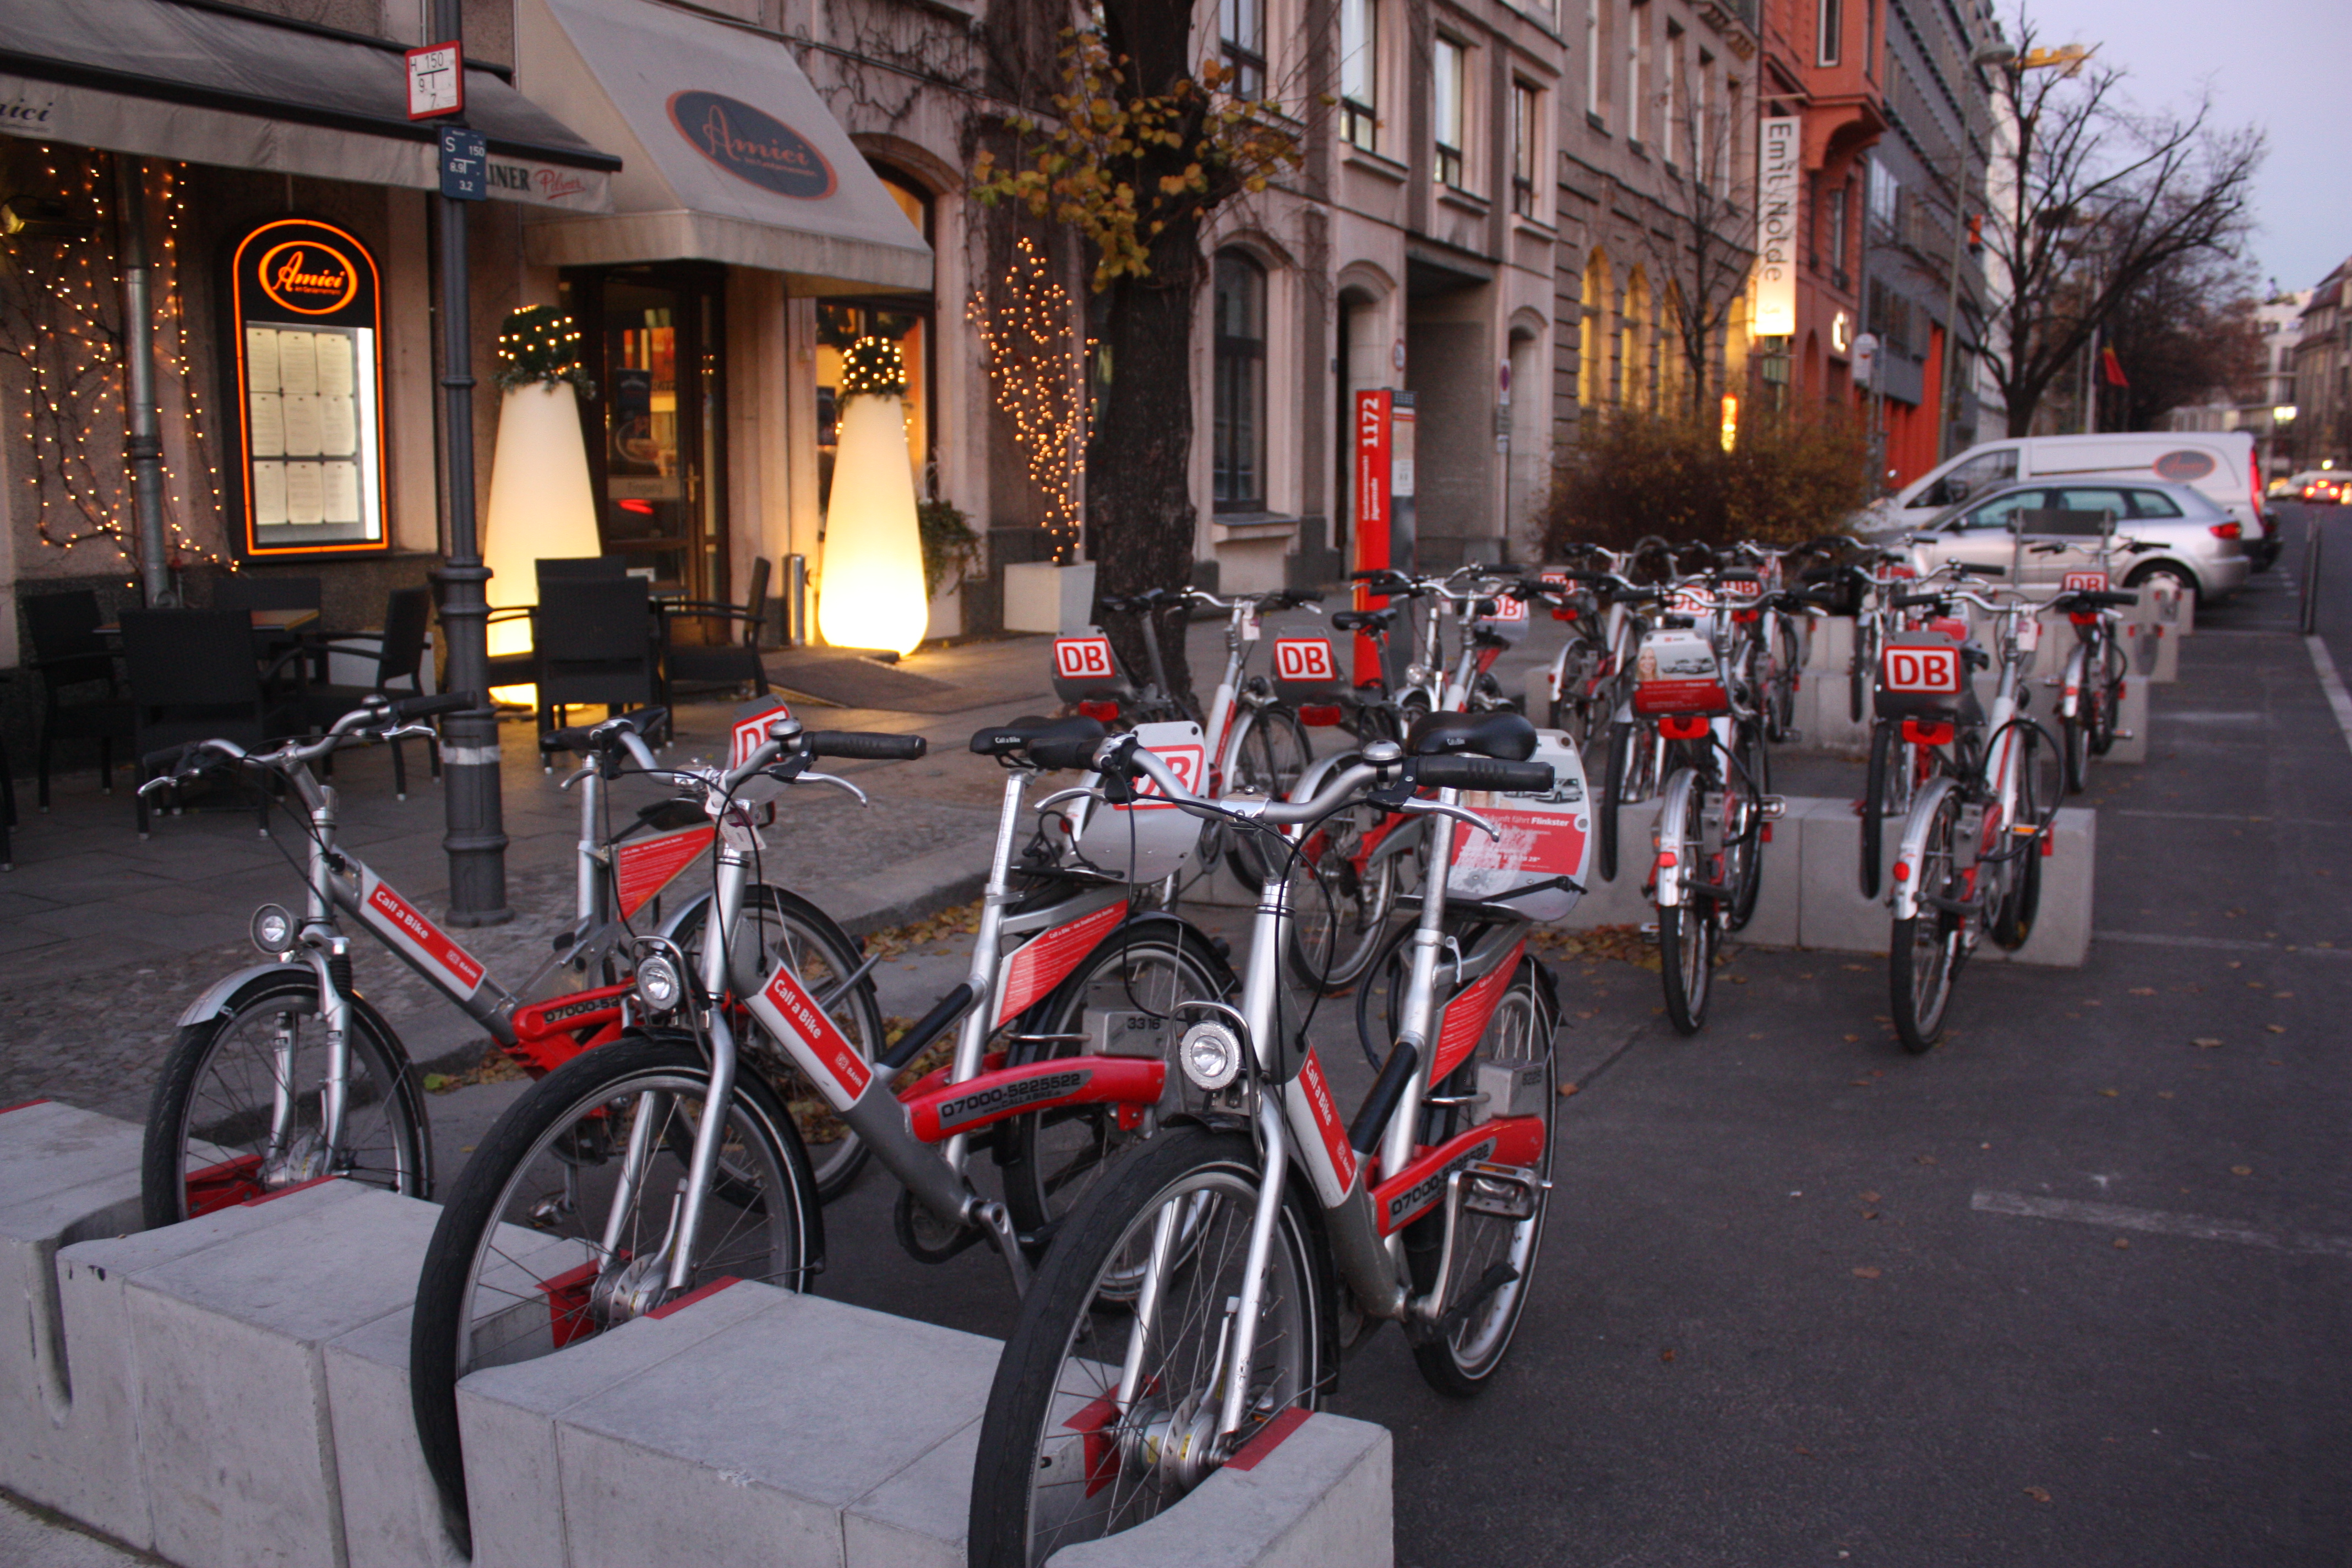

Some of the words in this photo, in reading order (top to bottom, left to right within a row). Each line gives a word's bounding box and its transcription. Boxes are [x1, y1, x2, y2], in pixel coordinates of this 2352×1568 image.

[426, 52, 444, 68] 150
[445, 137, 456, 153] S
[703, 104, 809, 166] Amici
[469, 145, 485, 157] 150
[1768, 122, 1792, 186] Emil
[459, 180, 473, 192] 3.2
[487, 163, 531, 192] INER
[1765, 201, 1789, 284] Nolde
[272, 251, 346, 292] Amici
[1362, 398, 1379, 448] 1172
[1062, 645, 1105, 672] DB
[1282, 646, 1326, 674] DB
[1893, 655, 1950, 686] DB
[1531, 817, 1569, 826] Flinkster
[376, 891, 399, 912] Call
[396, 908, 405, 919] a
[404, 914, 429, 939] Bike
[774, 979, 796, 1005] Call
[792, 1000, 801, 1014] a
[798, 1008, 823, 1039] Bike
[846, 1067, 863, 1088] BAHN
[1306, 1059, 1319, 1090] Call
[1315, 1086, 1321, 1098] a
[1319, 1092, 1332, 1126] Bike
